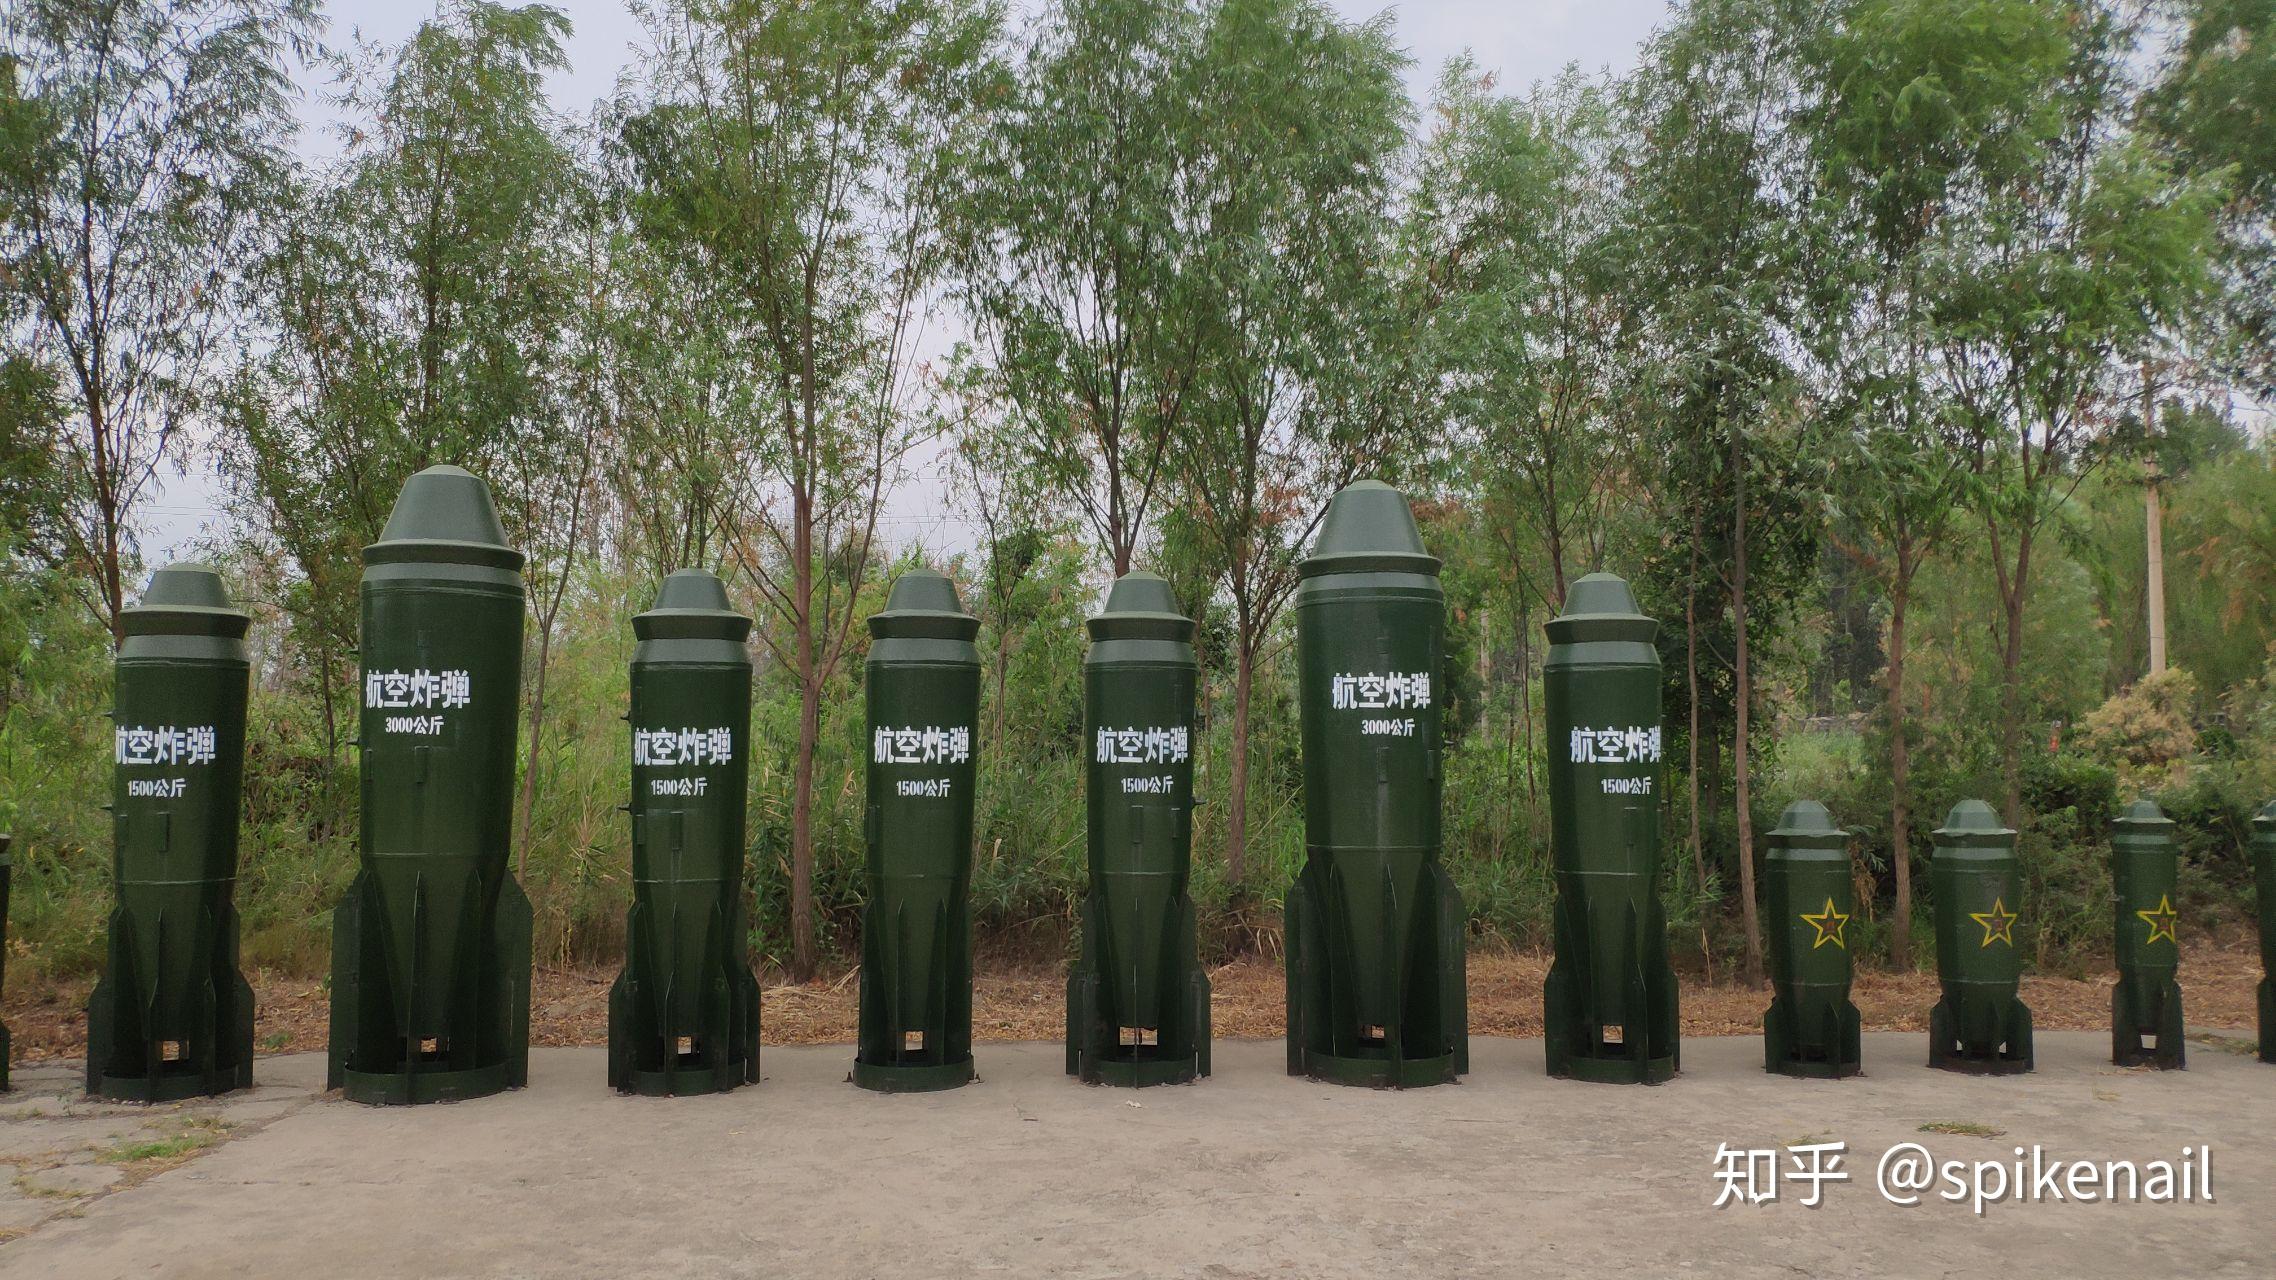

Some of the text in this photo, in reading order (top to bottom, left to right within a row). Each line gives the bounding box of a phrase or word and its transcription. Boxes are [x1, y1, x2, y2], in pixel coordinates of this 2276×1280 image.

[366, 669, 470, 708] 航空炸弹
[1332, 672, 1430, 709] 航空炸弹
[386, 716, 444, 735] 3000公斤
[1362, 719, 1415, 736] 3000公斤
[634, 727, 731, 765] 航空炸弹
[875, 726, 968, 764] 航空炸弹
[1097, 727, 1187, 763] 航空炸弹
[128, 778, 186, 797] 1500公斤
[652, 778, 707, 796] 1500公斤
[897, 779, 950, 797] 1500公斤
[1122, 776, 1173, 793] 1500公斤
[1601, 776, 1651, 794] 1500公斤
